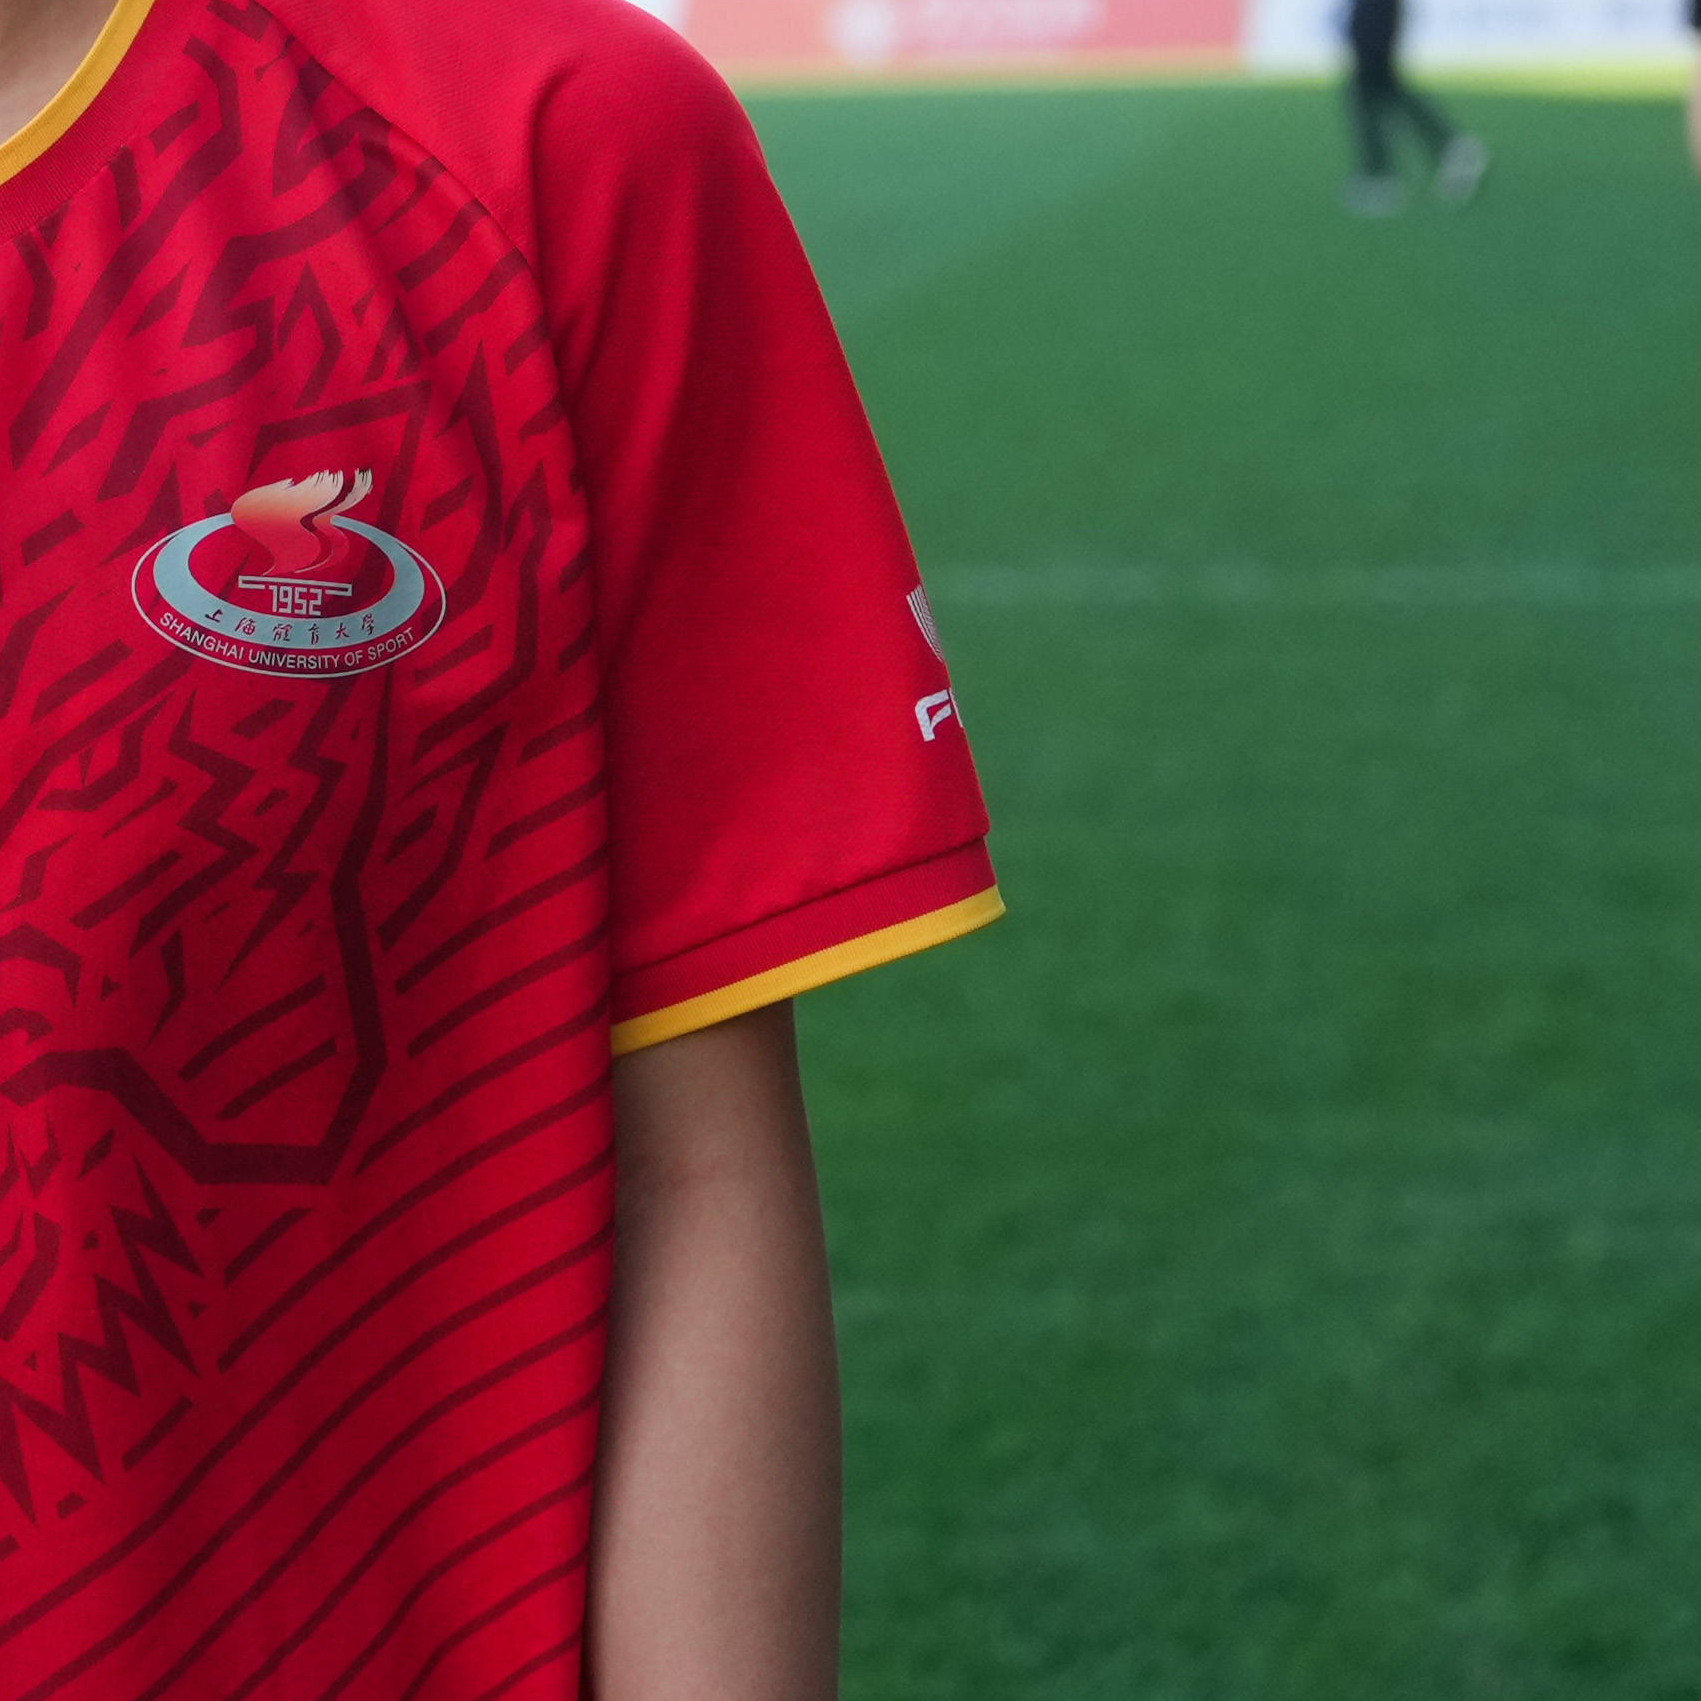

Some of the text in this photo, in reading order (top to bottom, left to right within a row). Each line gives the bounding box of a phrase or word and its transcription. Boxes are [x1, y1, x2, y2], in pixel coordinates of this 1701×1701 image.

[266, 584, 323, 617] 1952
[159, 612, 414, 670] SHANGHAI UNIVERSITY OF SPORT
